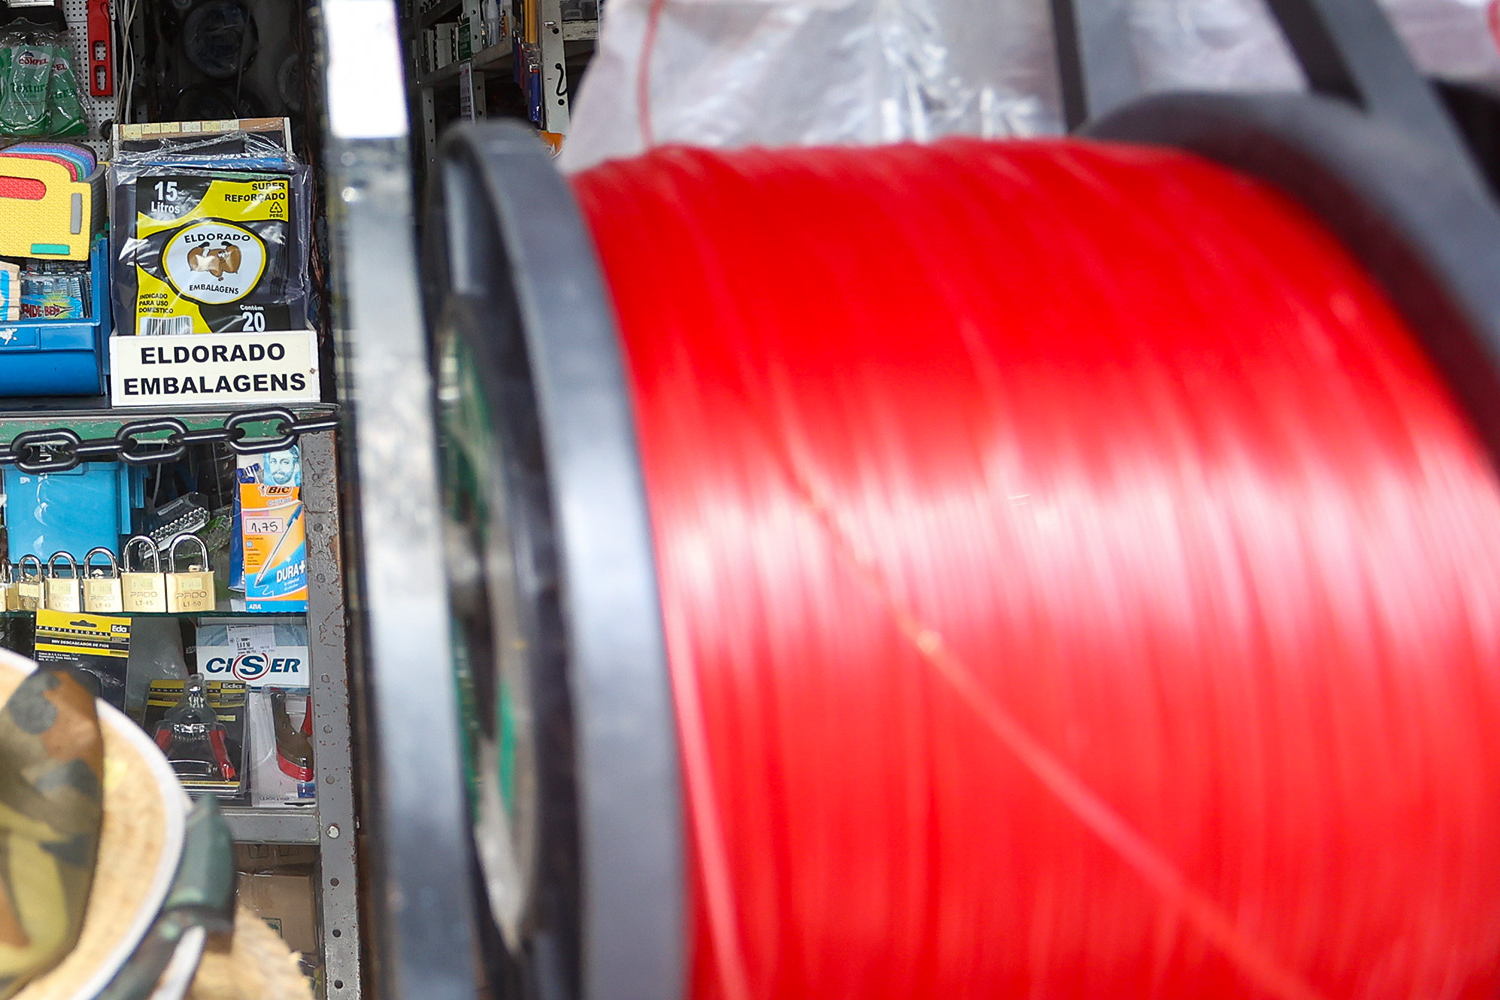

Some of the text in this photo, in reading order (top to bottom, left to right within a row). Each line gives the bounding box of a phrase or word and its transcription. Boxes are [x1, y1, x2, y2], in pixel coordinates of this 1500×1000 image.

[154, 181, 178, 200] 15
[252, 182, 285, 191] SUPER
[225, 192, 286, 203] REFORÇADO
[150, 201, 180, 215] Litros
[184, 233, 251, 244] ELDORADO
[189, 284, 239, 295] EMBALAGENS
[240, 304, 264, 312] Contém
[242, 312, 265, 332] 20
[141, 343, 285, 365] ELDORADO
[124, 373, 306, 396] EMBALAGENS
[268, 486, 290, 494] BIC
[251, 521, 278, 533] 1,75
[276, 560, 307, 584] DURA+
[130, 590, 158, 598] PADO
[176, 590, 208, 599] PADO
[38, 625, 111, 637] PROFISSIONAL
[112, 624, 127, 633] Eda
[206, 655, 301, 676] CISER
[222, 682, 243, 690] Eda
